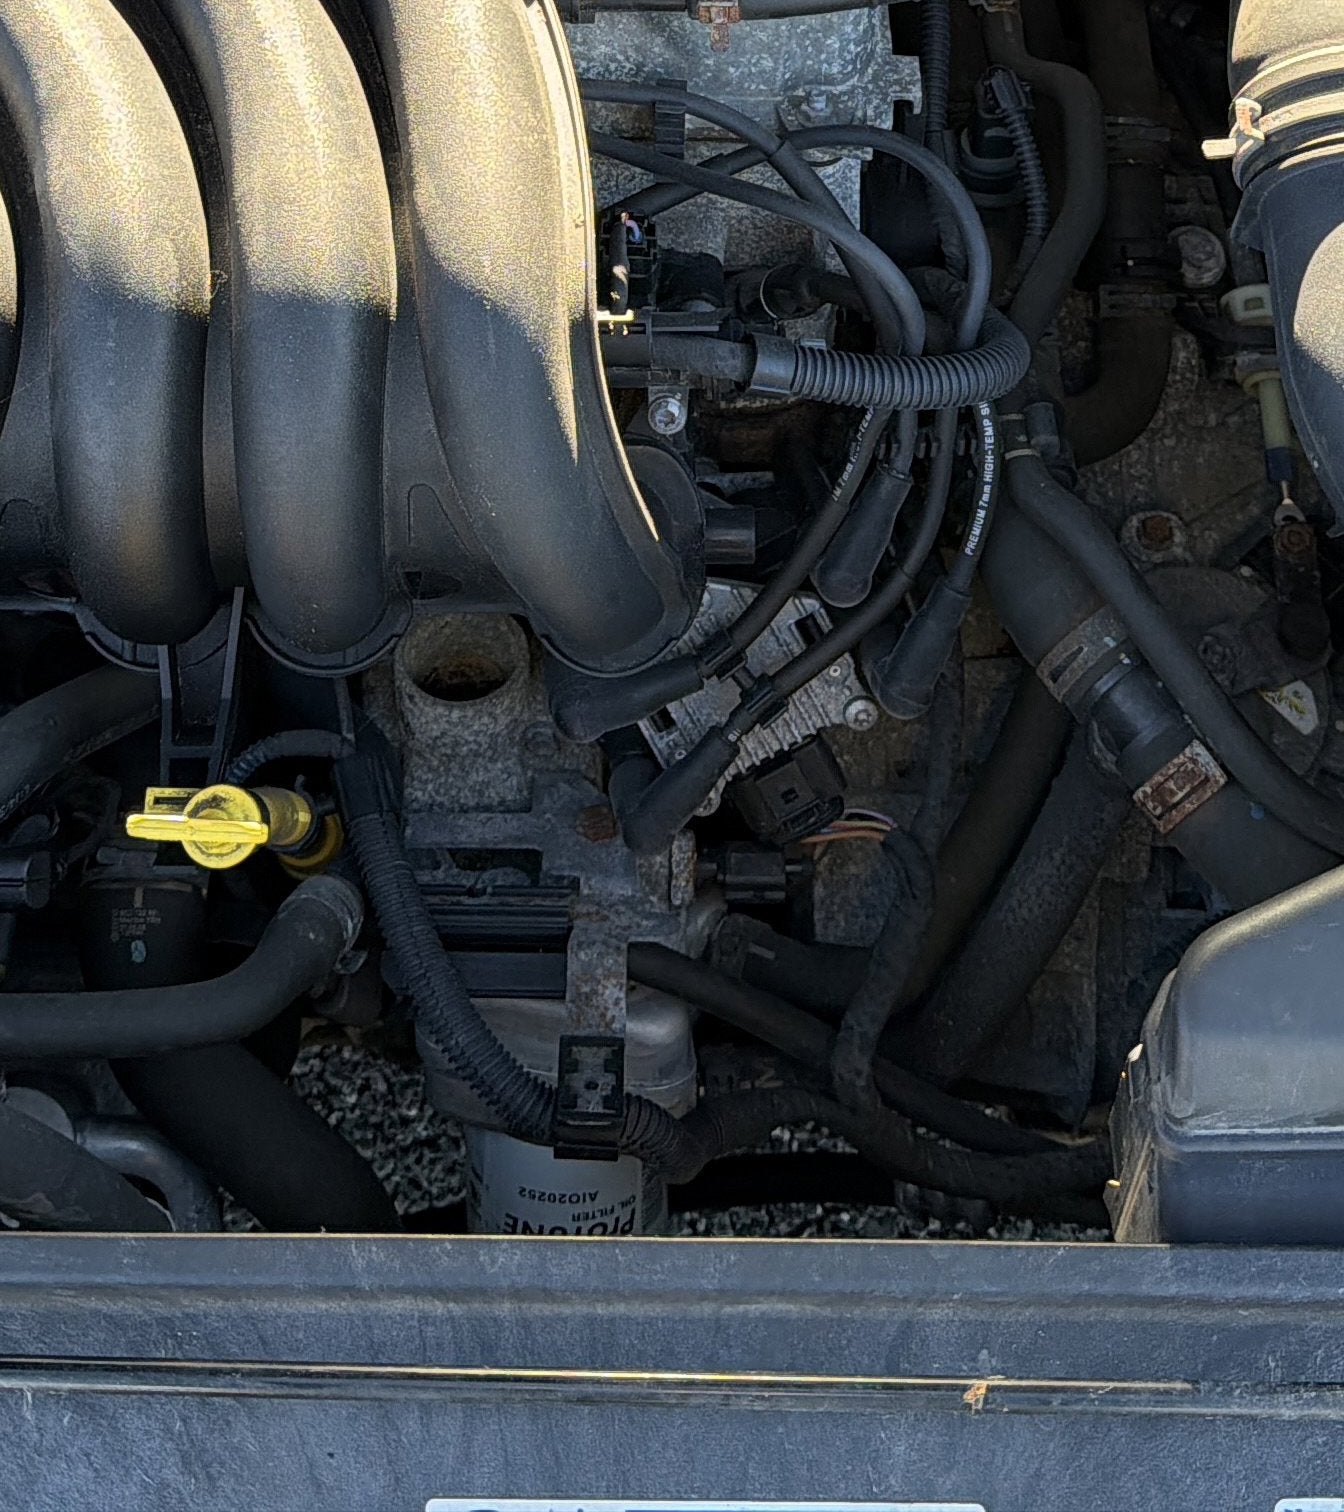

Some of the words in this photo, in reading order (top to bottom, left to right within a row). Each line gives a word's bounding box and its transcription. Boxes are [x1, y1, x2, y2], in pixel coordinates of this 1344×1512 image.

[983, 419, 991, 482] HIGH-TEMP
[978, 483, 991, 506] 7mm
[964, 508, 986, 555] PREMIUM
[571, 1205, 614, 1221] FILTER
[618, 1194, 635, 1209] OIL
